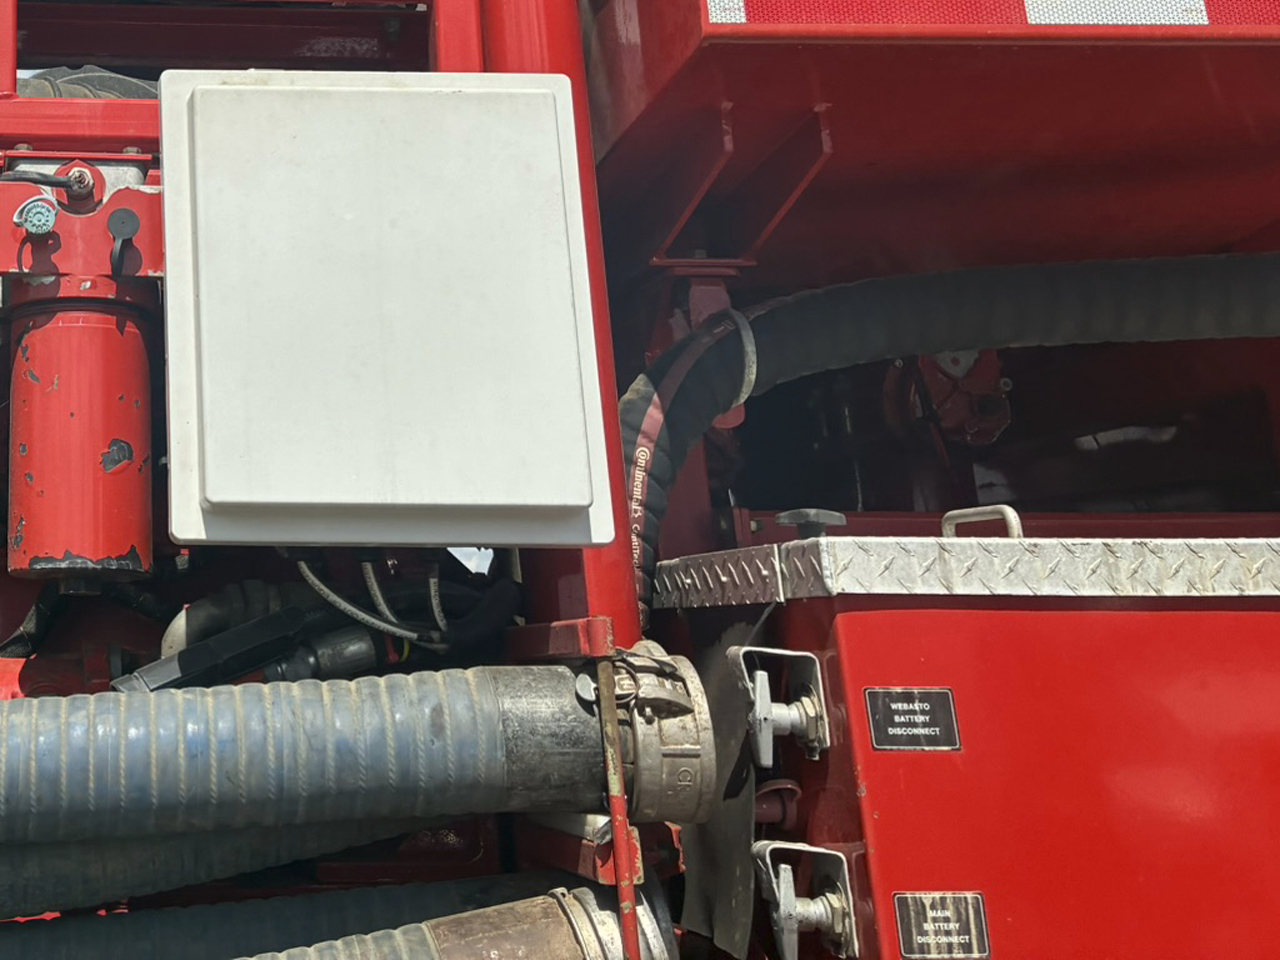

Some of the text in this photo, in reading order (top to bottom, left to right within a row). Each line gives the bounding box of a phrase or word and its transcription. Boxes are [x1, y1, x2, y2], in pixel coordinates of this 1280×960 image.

[890, 702, 931, 711] WEBASTO
[893, 714, 931, 723] BATTERY
[887, 727, 941, 736] DISCONNECT
[928, 909, 951, 917] MAIN
[923, 922, 960, 930] BATTERY
[916, 935, 970, 944] DISCONNECT
